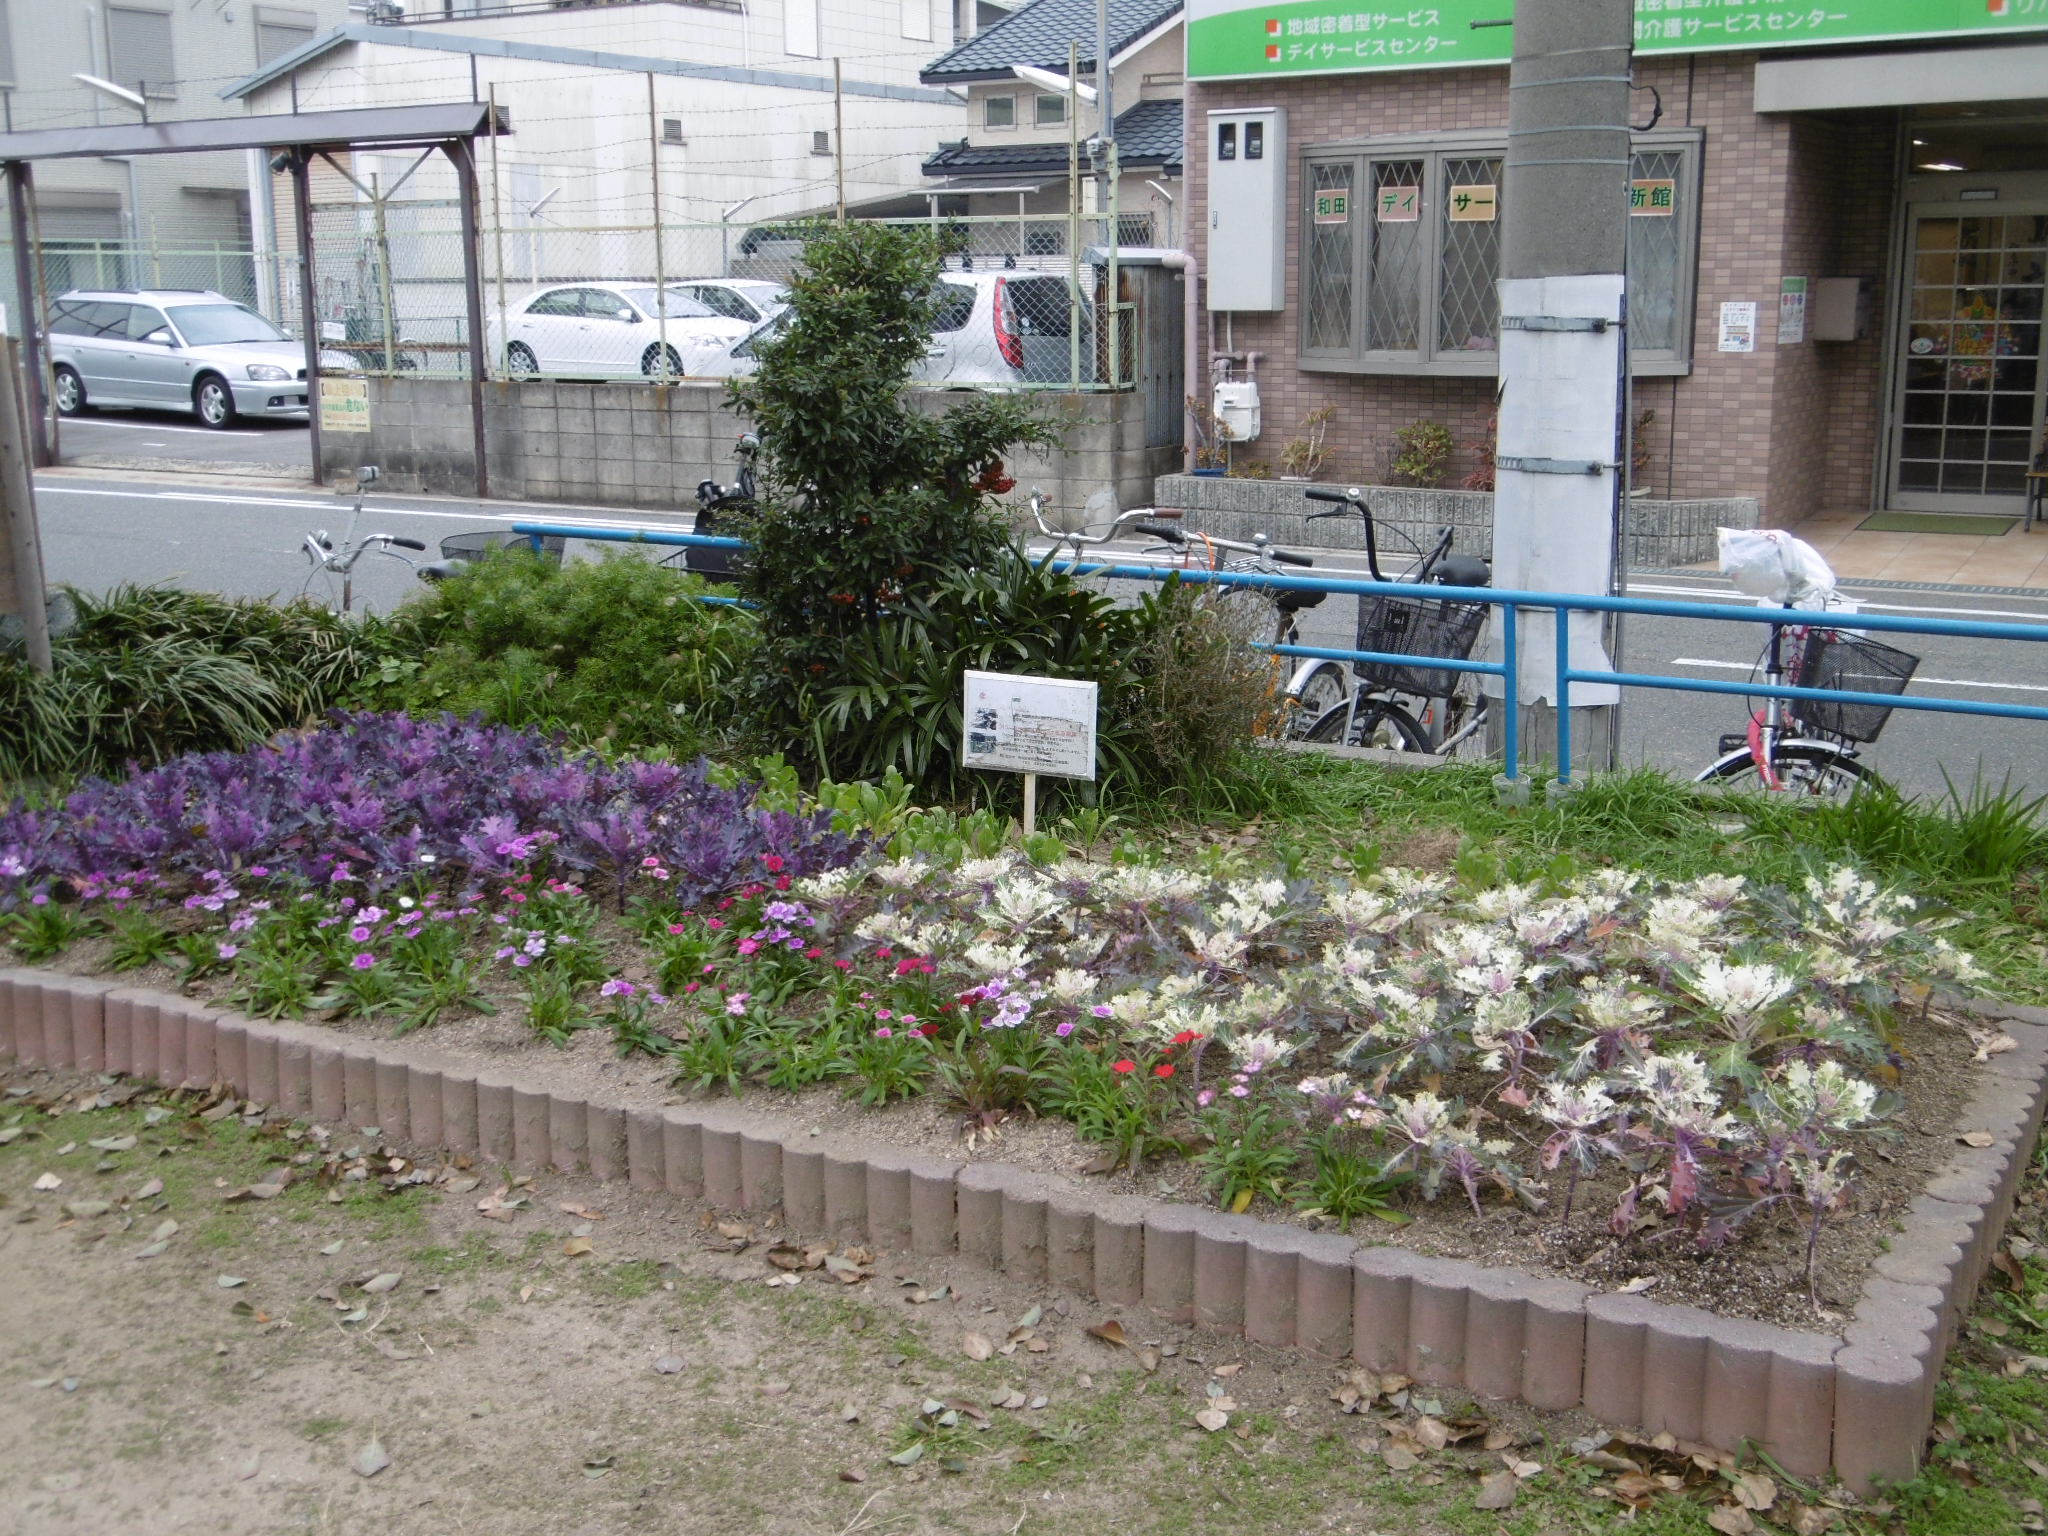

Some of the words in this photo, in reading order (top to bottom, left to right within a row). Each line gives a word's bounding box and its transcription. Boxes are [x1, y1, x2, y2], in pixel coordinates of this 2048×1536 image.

[1287, 9, 1441, 35] 地域密着型サービス
[1287, 35, 1458, 61] デイサービスセンター
[1317, 197, 1346, 216] 和田
[1382, 194, 1416, 213] デイ
[1454, 194, 1493, 212] サー
[1631, 187, 1672, 207] 新館
